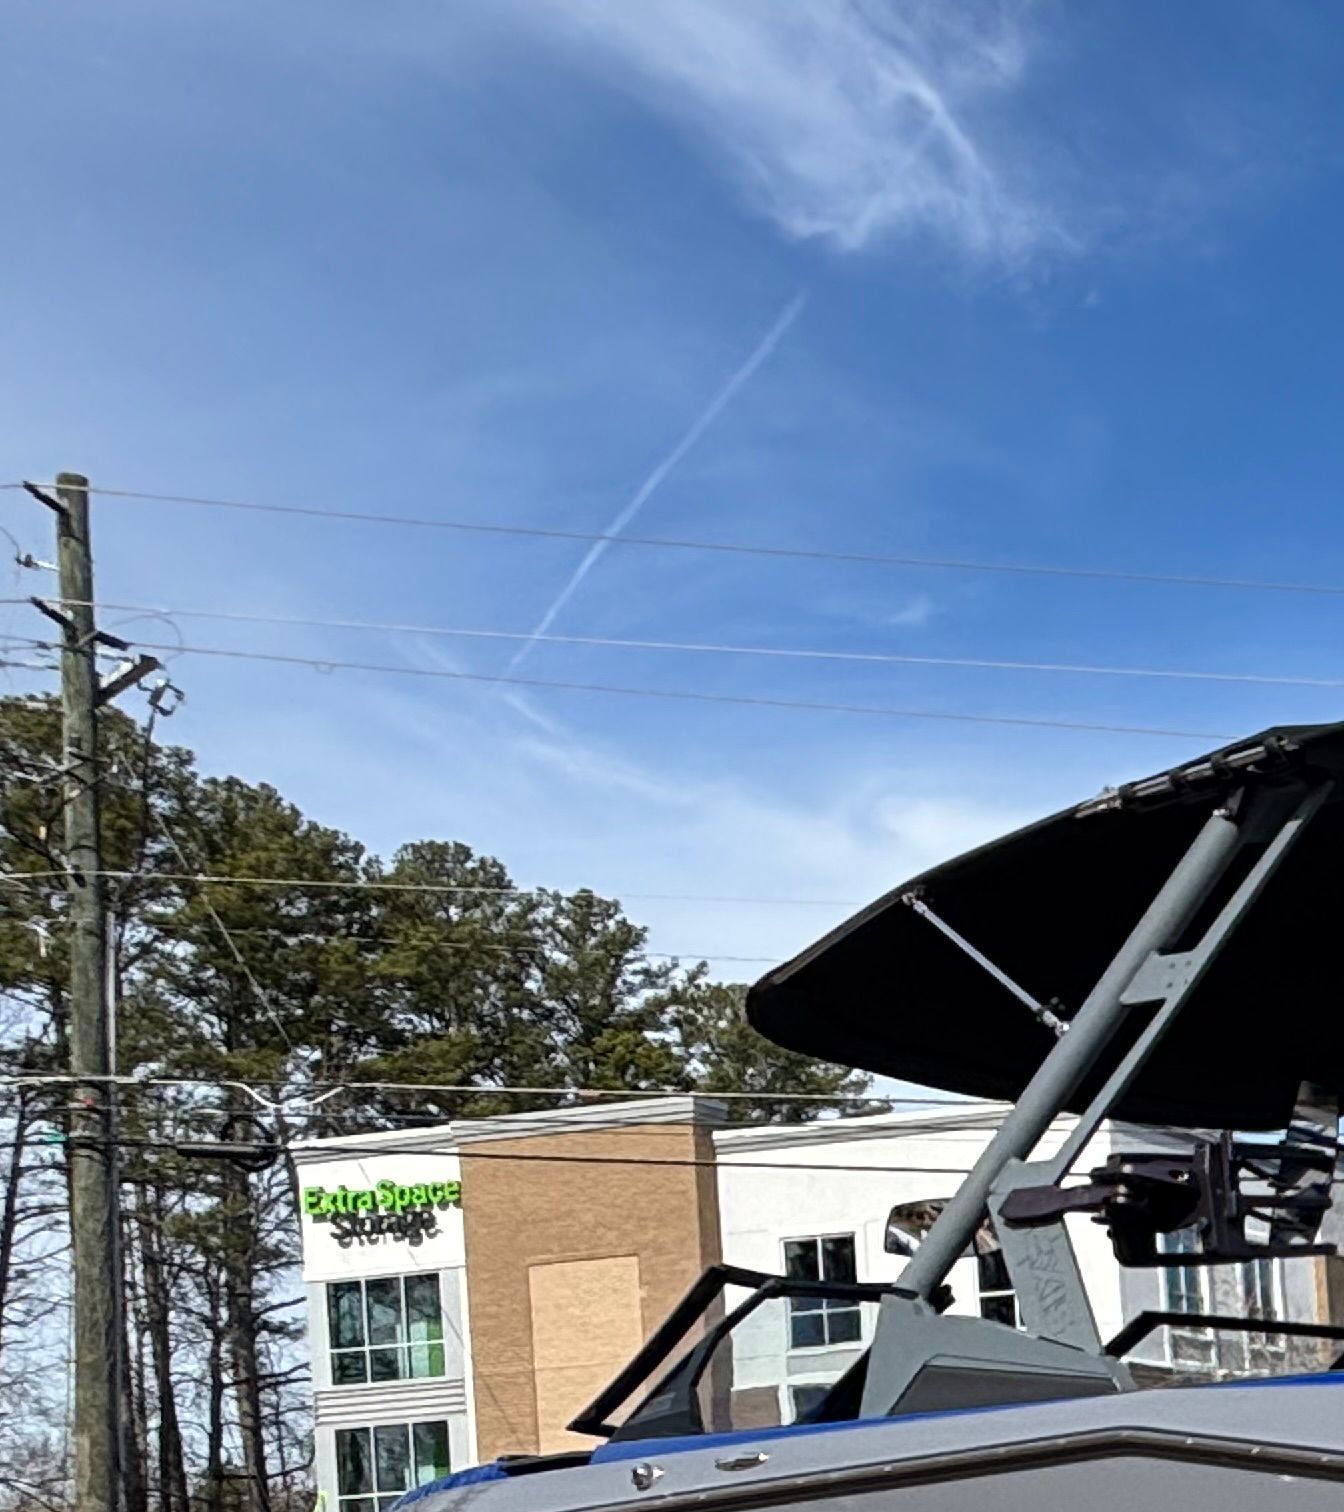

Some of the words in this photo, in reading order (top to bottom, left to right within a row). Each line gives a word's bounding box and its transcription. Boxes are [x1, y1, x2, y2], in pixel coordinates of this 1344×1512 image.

[304, 1185, 375, 1215] Extra
[377, 1179, 461, 1214] Space
[331, 1210, 438, 1244] Storage
